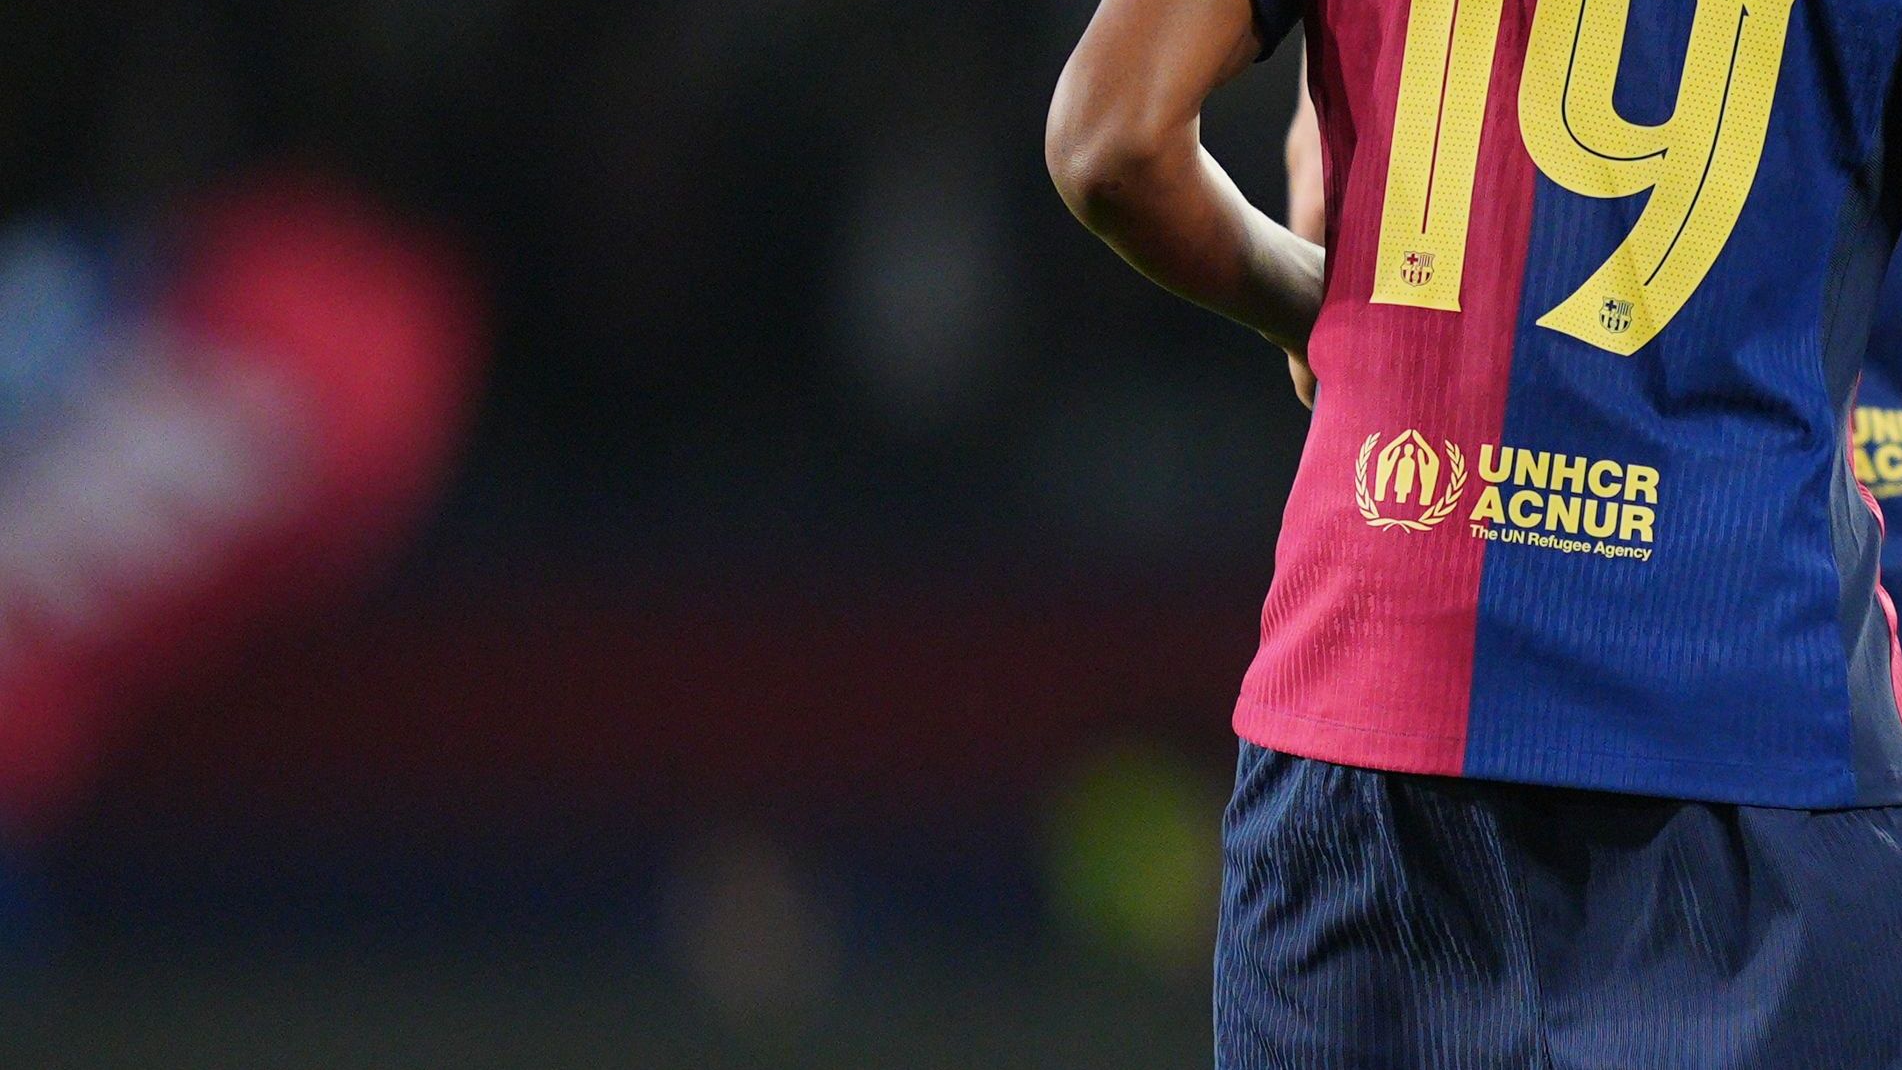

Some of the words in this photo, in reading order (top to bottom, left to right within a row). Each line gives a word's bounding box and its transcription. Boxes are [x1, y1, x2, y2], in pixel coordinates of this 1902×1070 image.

[1478, 444, 1660, 504] UNHCR
[1469, 486, 1656, 542] ACNUR
[1470, 524, 1499, 541] The
[1501, 529, 1526, 544] UN
[1528, 533, 1591, 554] Refugee
[1593, 541, 1652, 562] Agency
